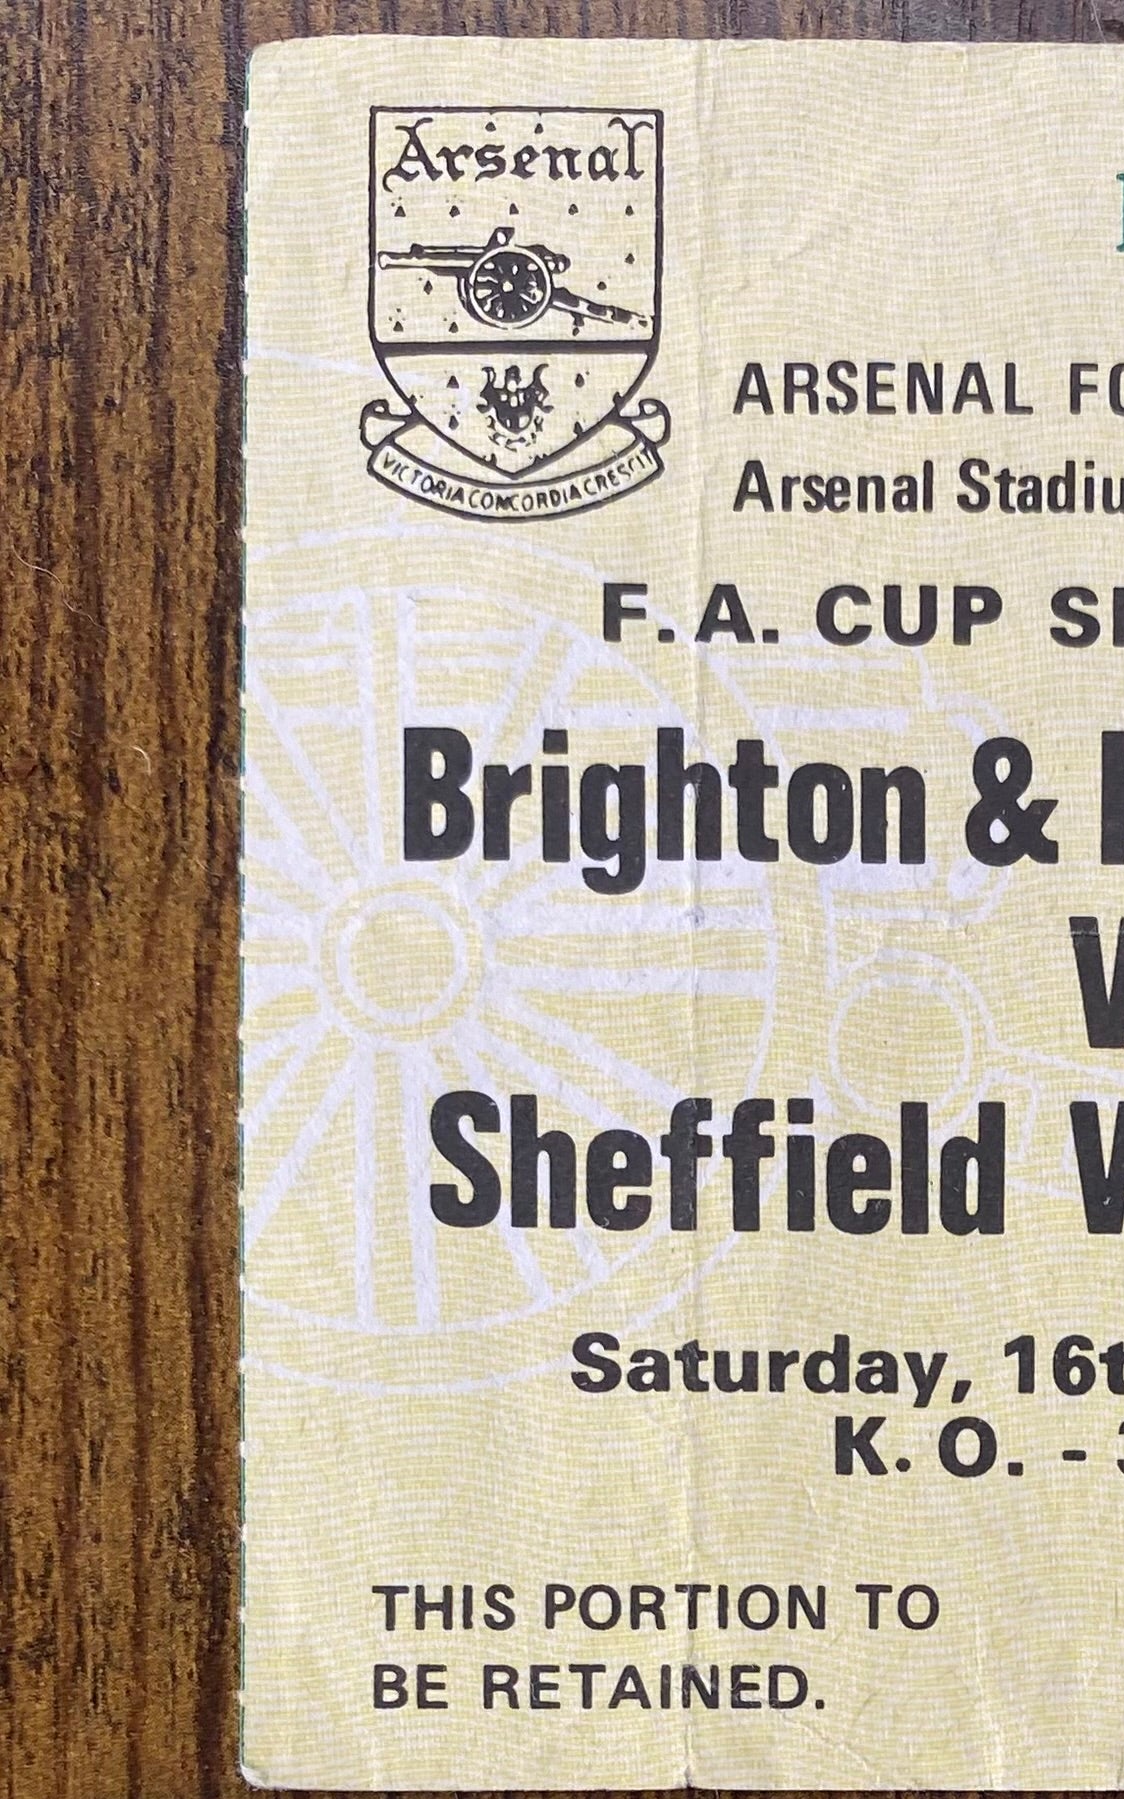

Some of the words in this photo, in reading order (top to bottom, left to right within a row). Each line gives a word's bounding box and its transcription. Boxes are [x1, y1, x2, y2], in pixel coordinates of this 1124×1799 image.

[383, 114, 655, 194] Arsenal
[732, 359, 1034, 416] ARSENAL
[732, 459, 934, 513] Arsenal
[815, 584, 1003, 647] CUP
[403, 726, 926, 895] Brighton
[964, 736, 1059, 868] &
[429, 1090, 1006, 1237] Sheffield
[570, 1331, 972, 1409] Saturday,
[371, 1583, 516, 1632] THIS
[544, 1583, 826, 1631] PORTION
[854, 1583, 940, 1631] TO
[373, 1663, 449, 1710] BE
[482, 1663, 825, 1710] RETAINED.
